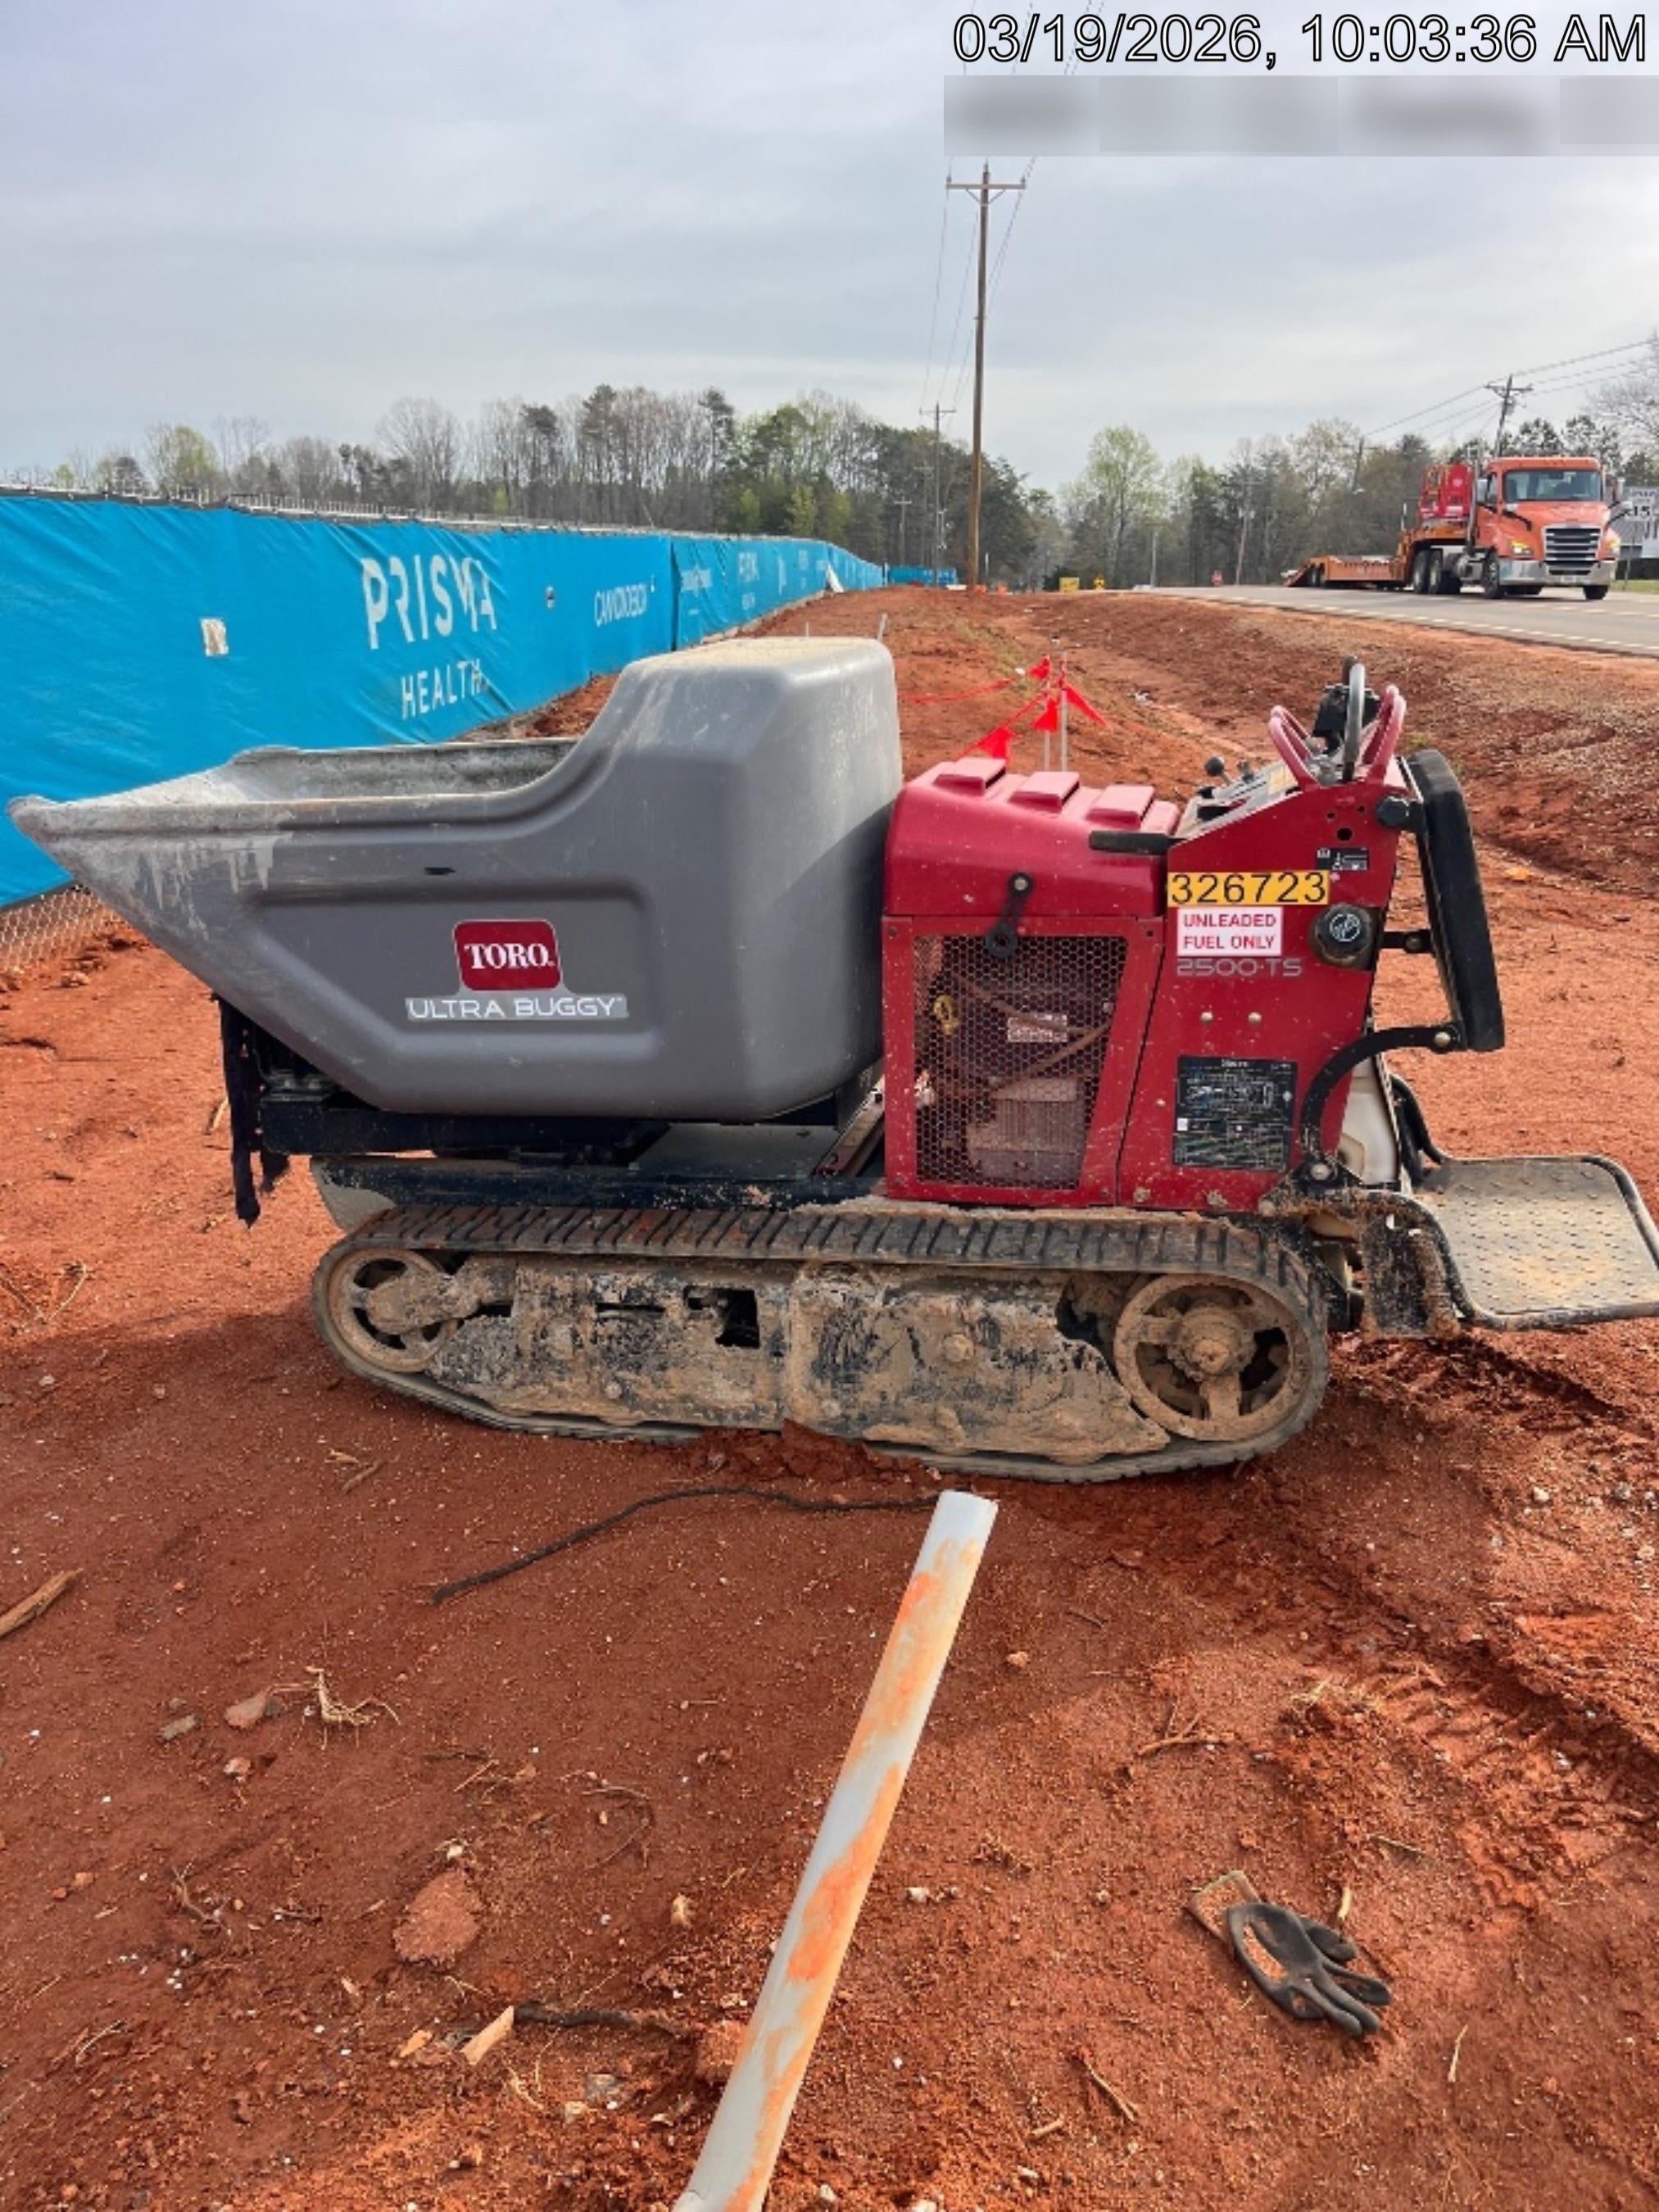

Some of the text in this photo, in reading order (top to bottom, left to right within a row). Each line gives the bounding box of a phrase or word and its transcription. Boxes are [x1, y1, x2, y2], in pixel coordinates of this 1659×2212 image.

[360, 554, 497, 650] PRISMA
[400, 658, 482, 720] HEALTH
[1172, 872, 1326, 903] 326723
[1184, 913, 1276, 927] UNLEADED
[1184, 935, 1275, 949] FUEL ONLY
[464, 943, 551, 969] TORO
[409, 996, 616, 1018] ULTRA BUGGY
